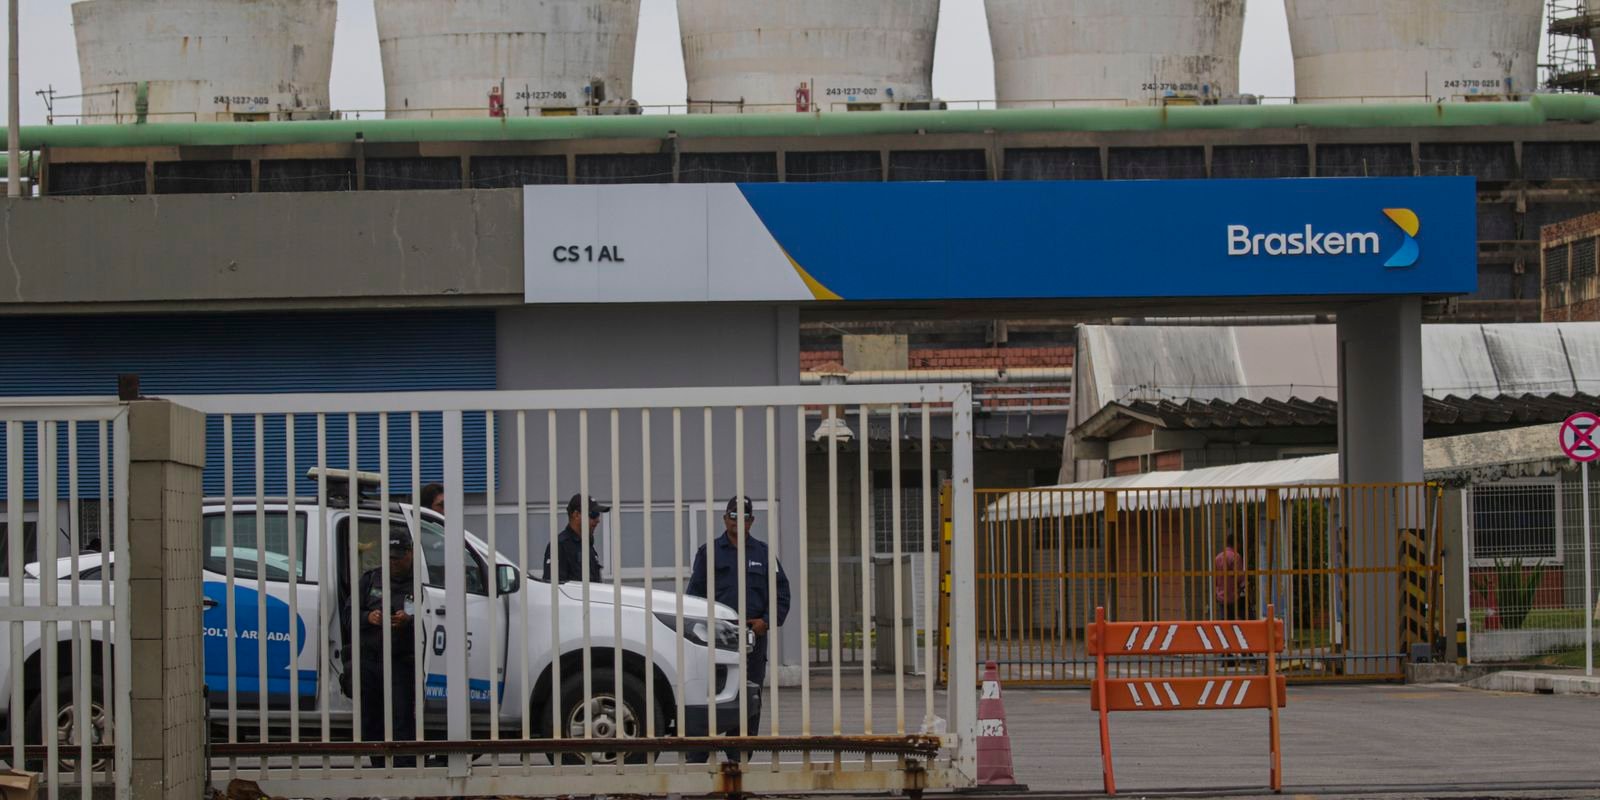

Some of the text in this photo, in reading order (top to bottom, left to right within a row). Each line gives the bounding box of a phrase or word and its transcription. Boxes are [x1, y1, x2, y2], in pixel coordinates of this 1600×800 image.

[1227, 224, 1380, 256] Braskem
[553, 245, 624, 262] CS 1 AL
[241, 630, 292, 641] ARADA
